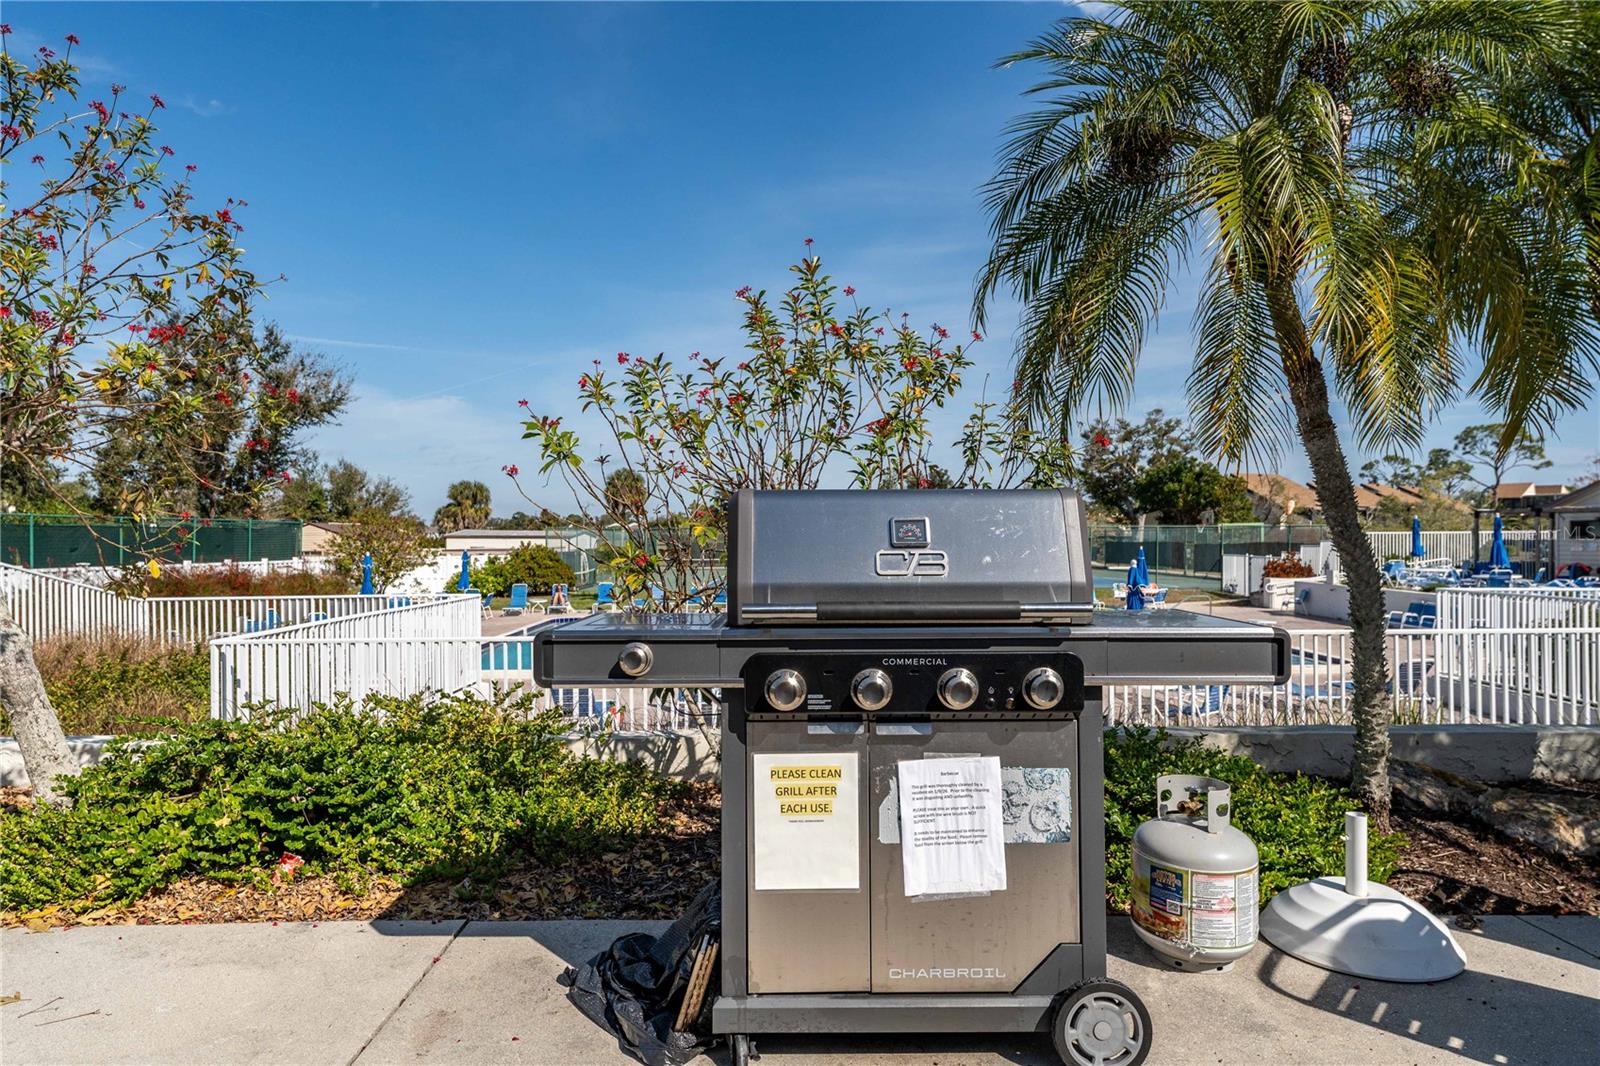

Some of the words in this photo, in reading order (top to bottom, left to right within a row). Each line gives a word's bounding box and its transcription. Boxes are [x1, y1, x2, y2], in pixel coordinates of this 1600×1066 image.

[770, 770, 806, 779] PLEASE
[809, 769, 842, 778] CLEAN
[776, 787, 804, 796] GRILL
[806, 786, 837, 796] AFTER
[780, 804, 806, 813] EACH
[810, 804, 832, 813] USE.
[889, 968, 1006, 978] CHARBROIL
